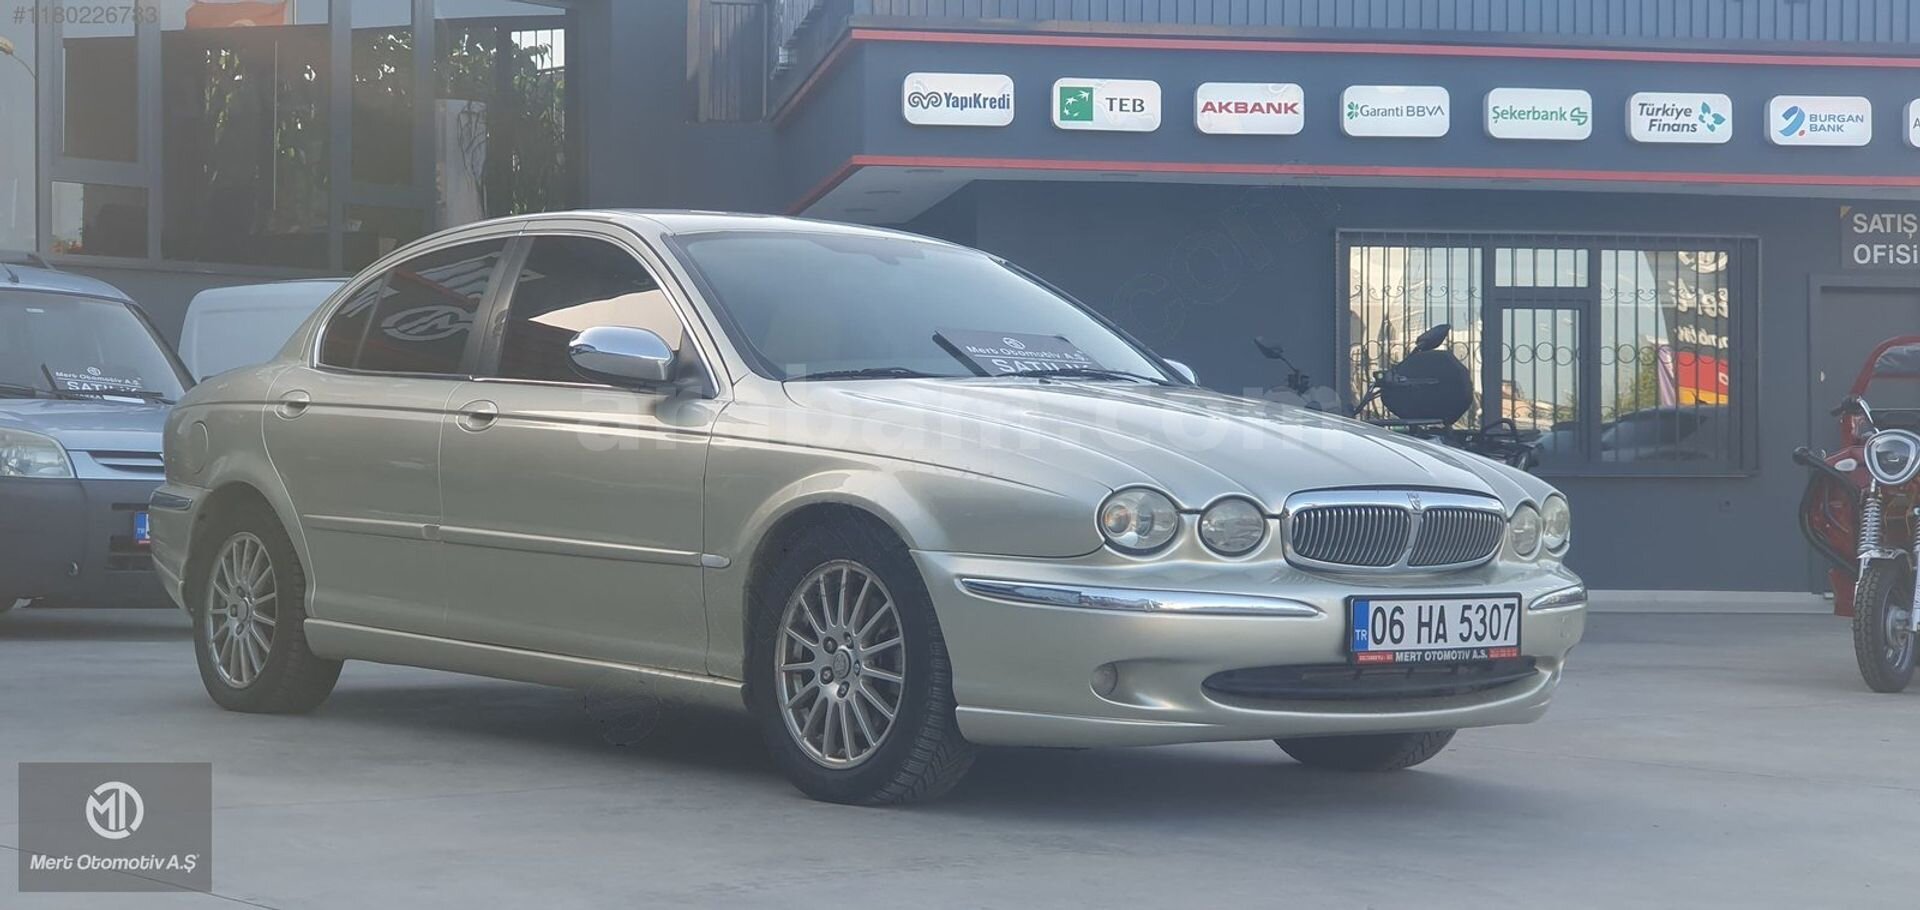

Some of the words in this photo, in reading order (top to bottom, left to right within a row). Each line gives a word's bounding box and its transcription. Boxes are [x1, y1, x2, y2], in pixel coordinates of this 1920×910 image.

[1105, 97, 1145, 113] TEB
[1201, 100, 1300, 114] AKBANK
[1359, 104, 1403, 118] Garanti
[1406, 105, 1445, 117] BBVA
[1638, 102, 1693, 118] Türkiye
[1492, 105, 1567, 124] Şekerbank
[1809, 113, 1864, 124] BURGAN
[1648, 118, 1698, 133] Finans
[1809, 123, 1845, 133] BANK
[1853, 213, 1918, 239] SATIŞ
[1371, 605, 1405, 646] 06
[1417, 605, 1448, 645] HA
[1459, 603, 1516, 643] 5307
[1355, 629, 1368, 641] TR
[1395, 651, 1422, 663] MERT
